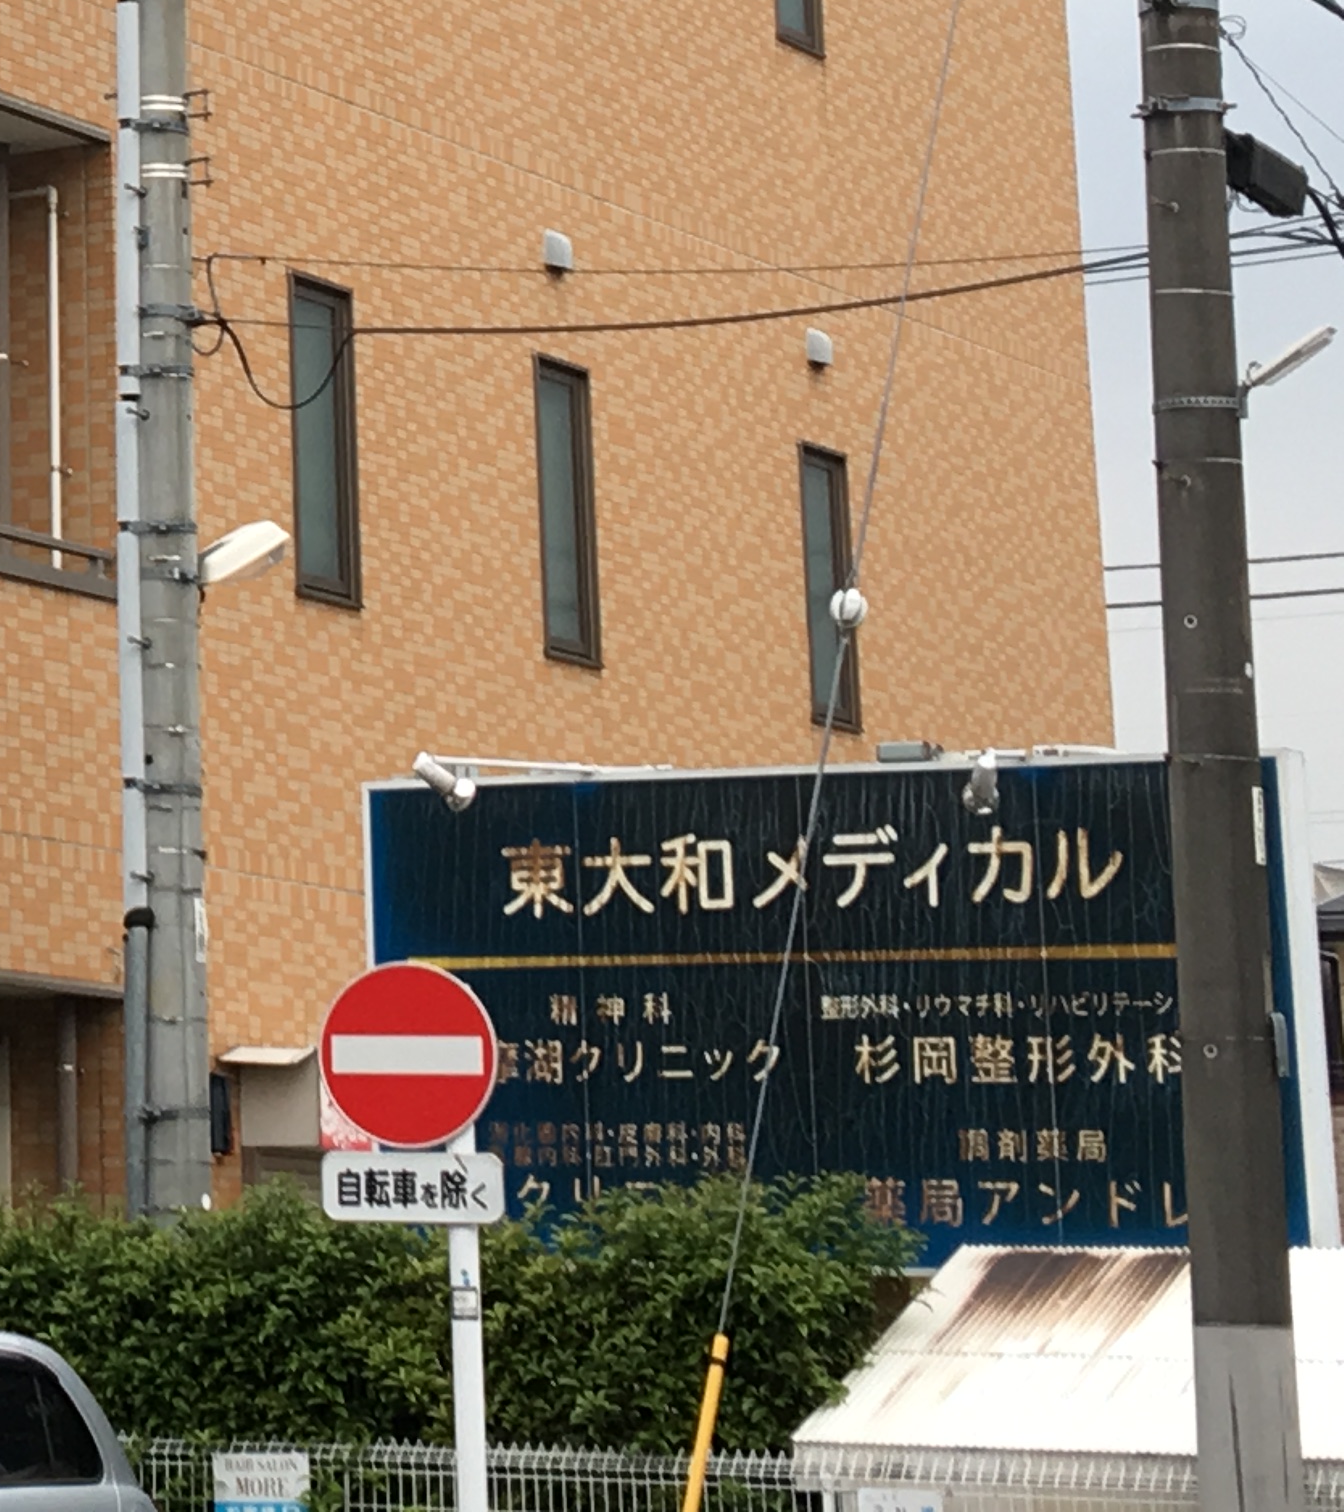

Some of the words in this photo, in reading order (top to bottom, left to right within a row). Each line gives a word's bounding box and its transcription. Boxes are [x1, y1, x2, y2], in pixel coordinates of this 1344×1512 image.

[500, 824, 1123, 918] 東大和メディカル
[549, 992, 672, 1026] 精神科
[855, 1032, 1182, 1085] 杉岡整形外科
[959, 1129, 1107, 1163] 調剤薬局
[337, 1168, 488, 1210] 自転車を除く
[257, 1458, 298, 1472] SALON
[236, 1476, 288, 1497] MORE
